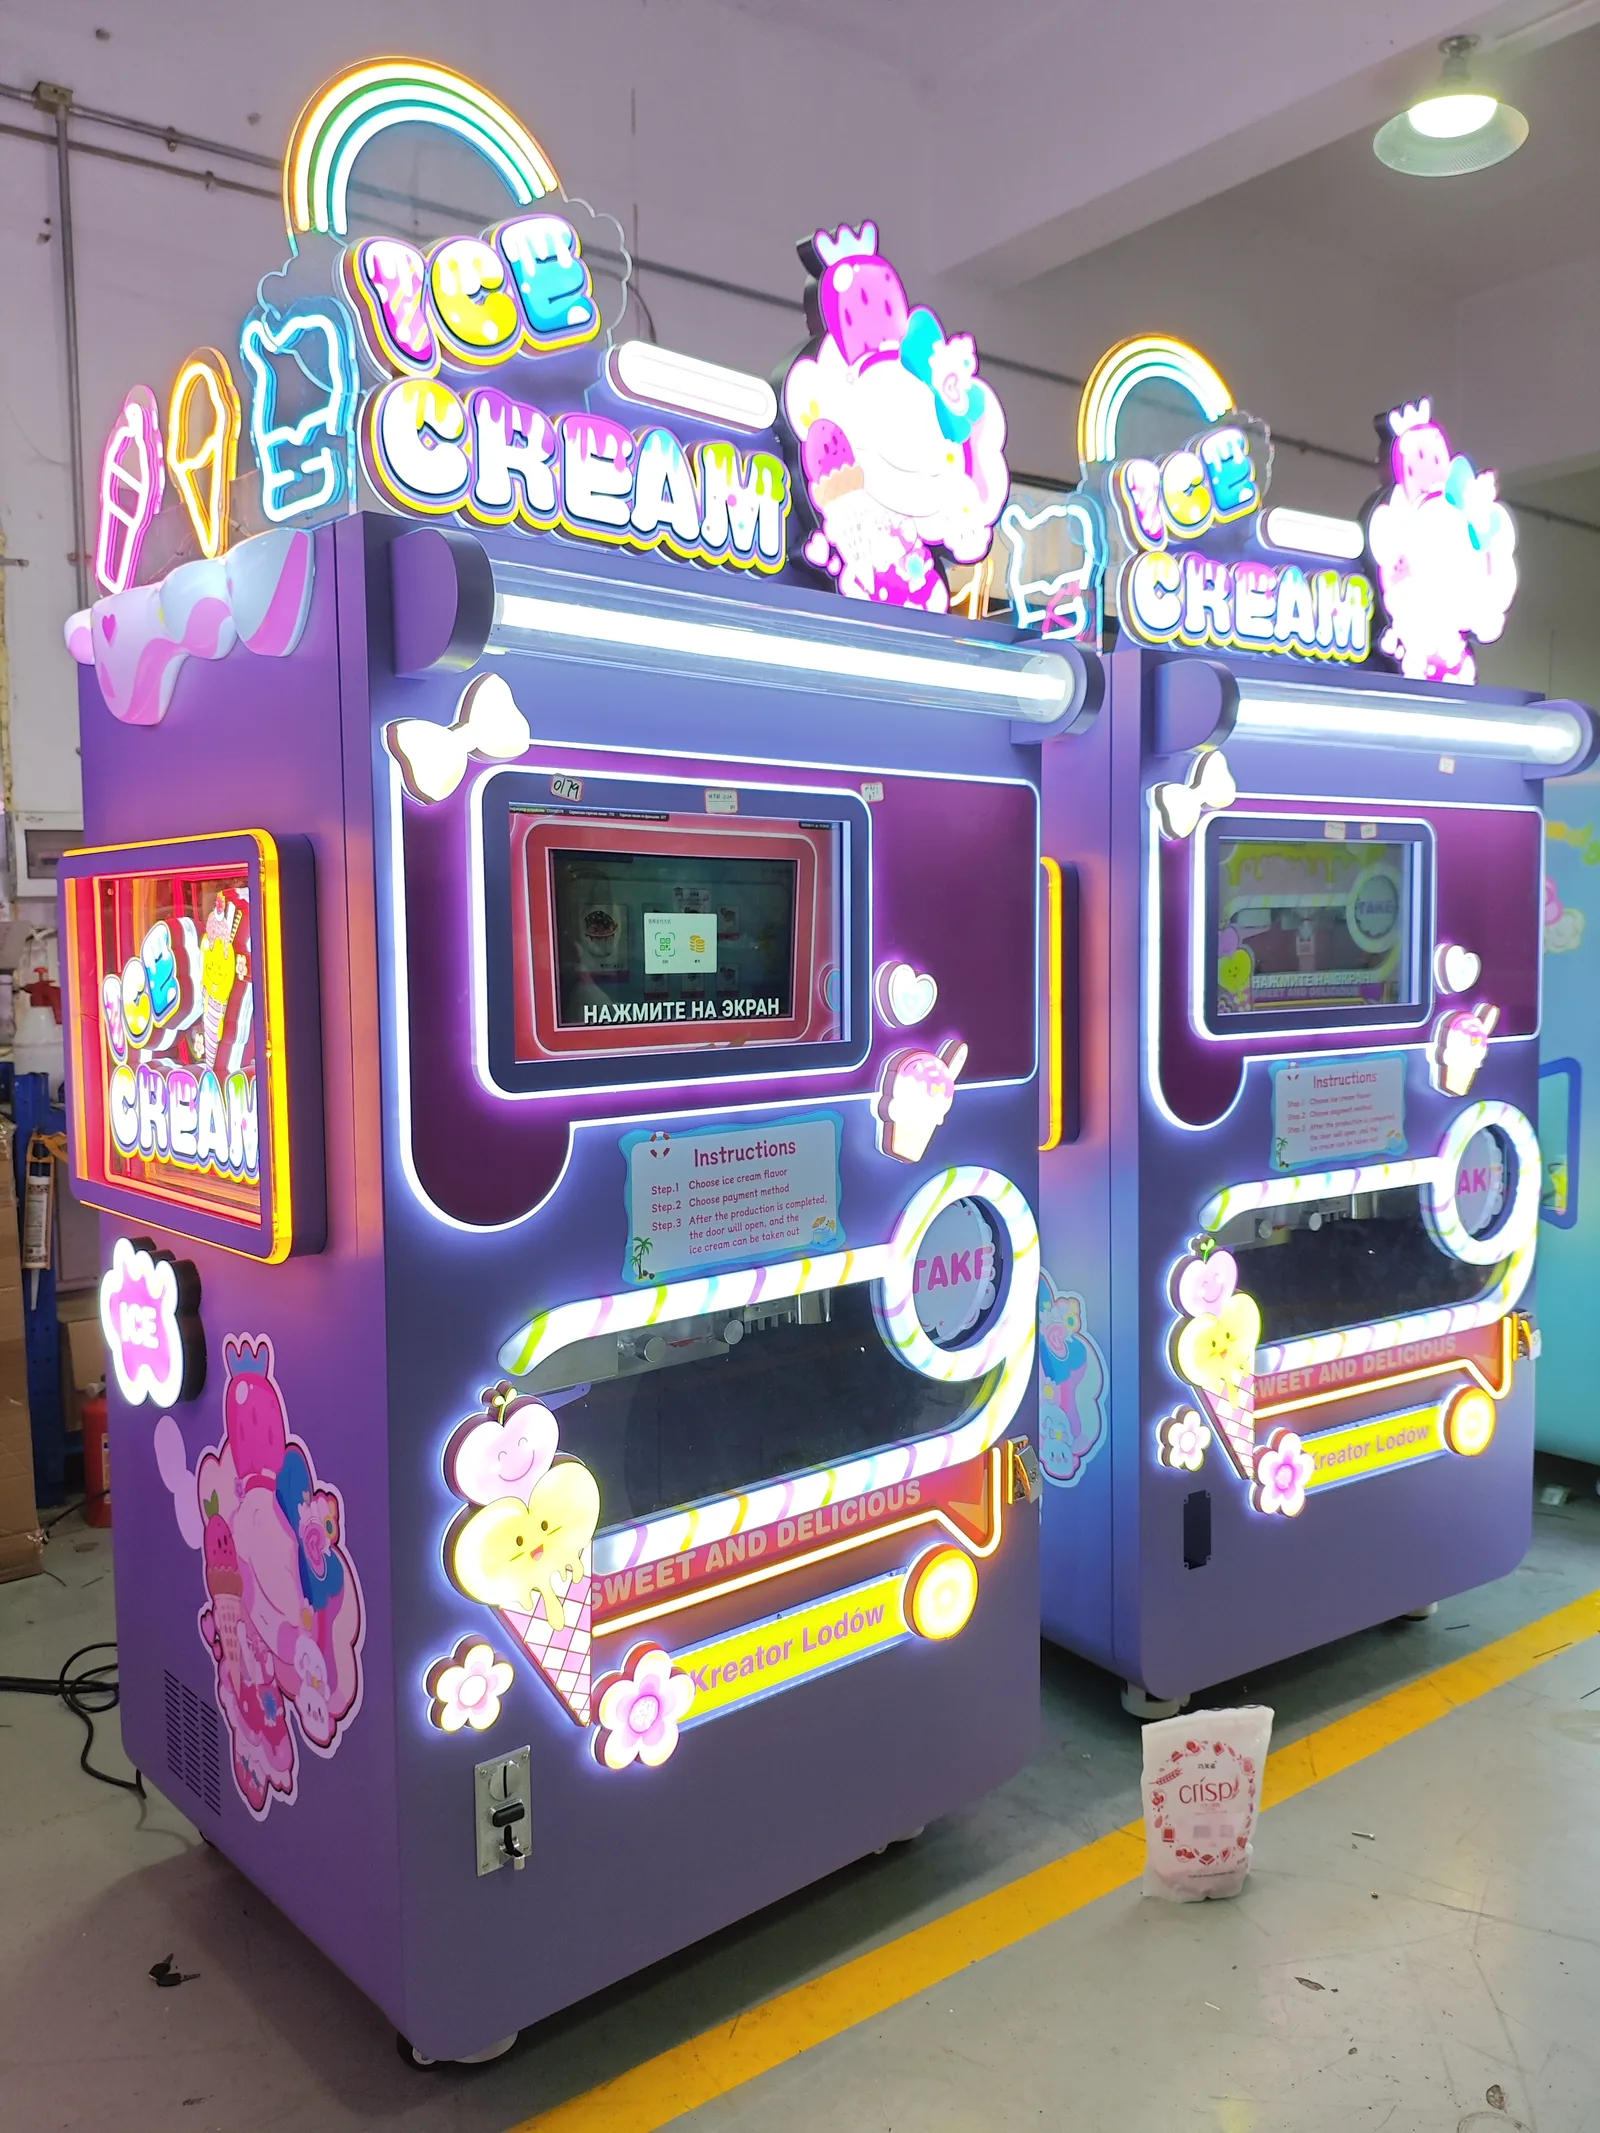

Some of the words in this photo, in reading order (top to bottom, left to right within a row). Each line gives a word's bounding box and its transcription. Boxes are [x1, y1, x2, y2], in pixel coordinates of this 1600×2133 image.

[357, 215, 598, 372] ICE
[375, 377, 790, 570] CREAM
[1122, 427, 1260, 548] ICE
[1130, 552, 1373, 659] CREAM
[102, 920, 179, 1062] ICE
[583, 1002, 686, 1024] НАЖМИТЕ
[691, 1000, 717, 1019] НА
[722, 998, 780, 1018] ЭКРАН
[1313, 1071, 1378, 1088] Instructions
[694, 1140, 796, 1167] Instructions
[652, 1182, 679, 1196] Step.1
[689, 1179, 720, 1190] Choose
[722, 1176, 735, 1185] ice
[737, 1172, 761, 1183] cream
[764, 1168, 788, 1179] flavor
[652, 1200, 682, 1214] Step.2
[689, 1197, 720, 1208] Choose
[722, 1190, 758, 1204] payment
[760, 1183, 790, 1196] method
[652, 1218, 682, 1232] Step.3
[689, 1215, 712, 1225] After
[715, 1211, 729, 1222] the
[730, 1203, 775, 1221] production
[777, 1201, 783, 1211] is
[785, 1194, 828, 1210] completed,
[689, 1230, 703, 1240] the
[705, 1225, 724, 1237] door
[727, 1222, 743, 1234] will
[744, 1219, 767, 1232] open,
[769, 1216, 785, 1227] and
[787, 1213, 799, 1223] the
[689, 1245, 702, 1255] ice
[704, 1241, 731, 1252] cream
[732, 1237, 748, 1248] can
[749, 1233, 760, 1244] be
[761, 1230, 785, 1243] taken
[786, 1227, 800, 1238] out
[120, 1301, 160, 1350] ICE
[1318, 1358, 1357, 1385] AND
[1363, 1335, 1456, 1374] DELICIOUS
[1376, 1424, 1431, 1452] Lodów
[705, 1535, 767, 1573] AND
[777, 1479, 921, 1549] DELICIOUS
[691, 1640, 791, 1694] Kreator
[802, 1602, 885, 1653] Lodów
